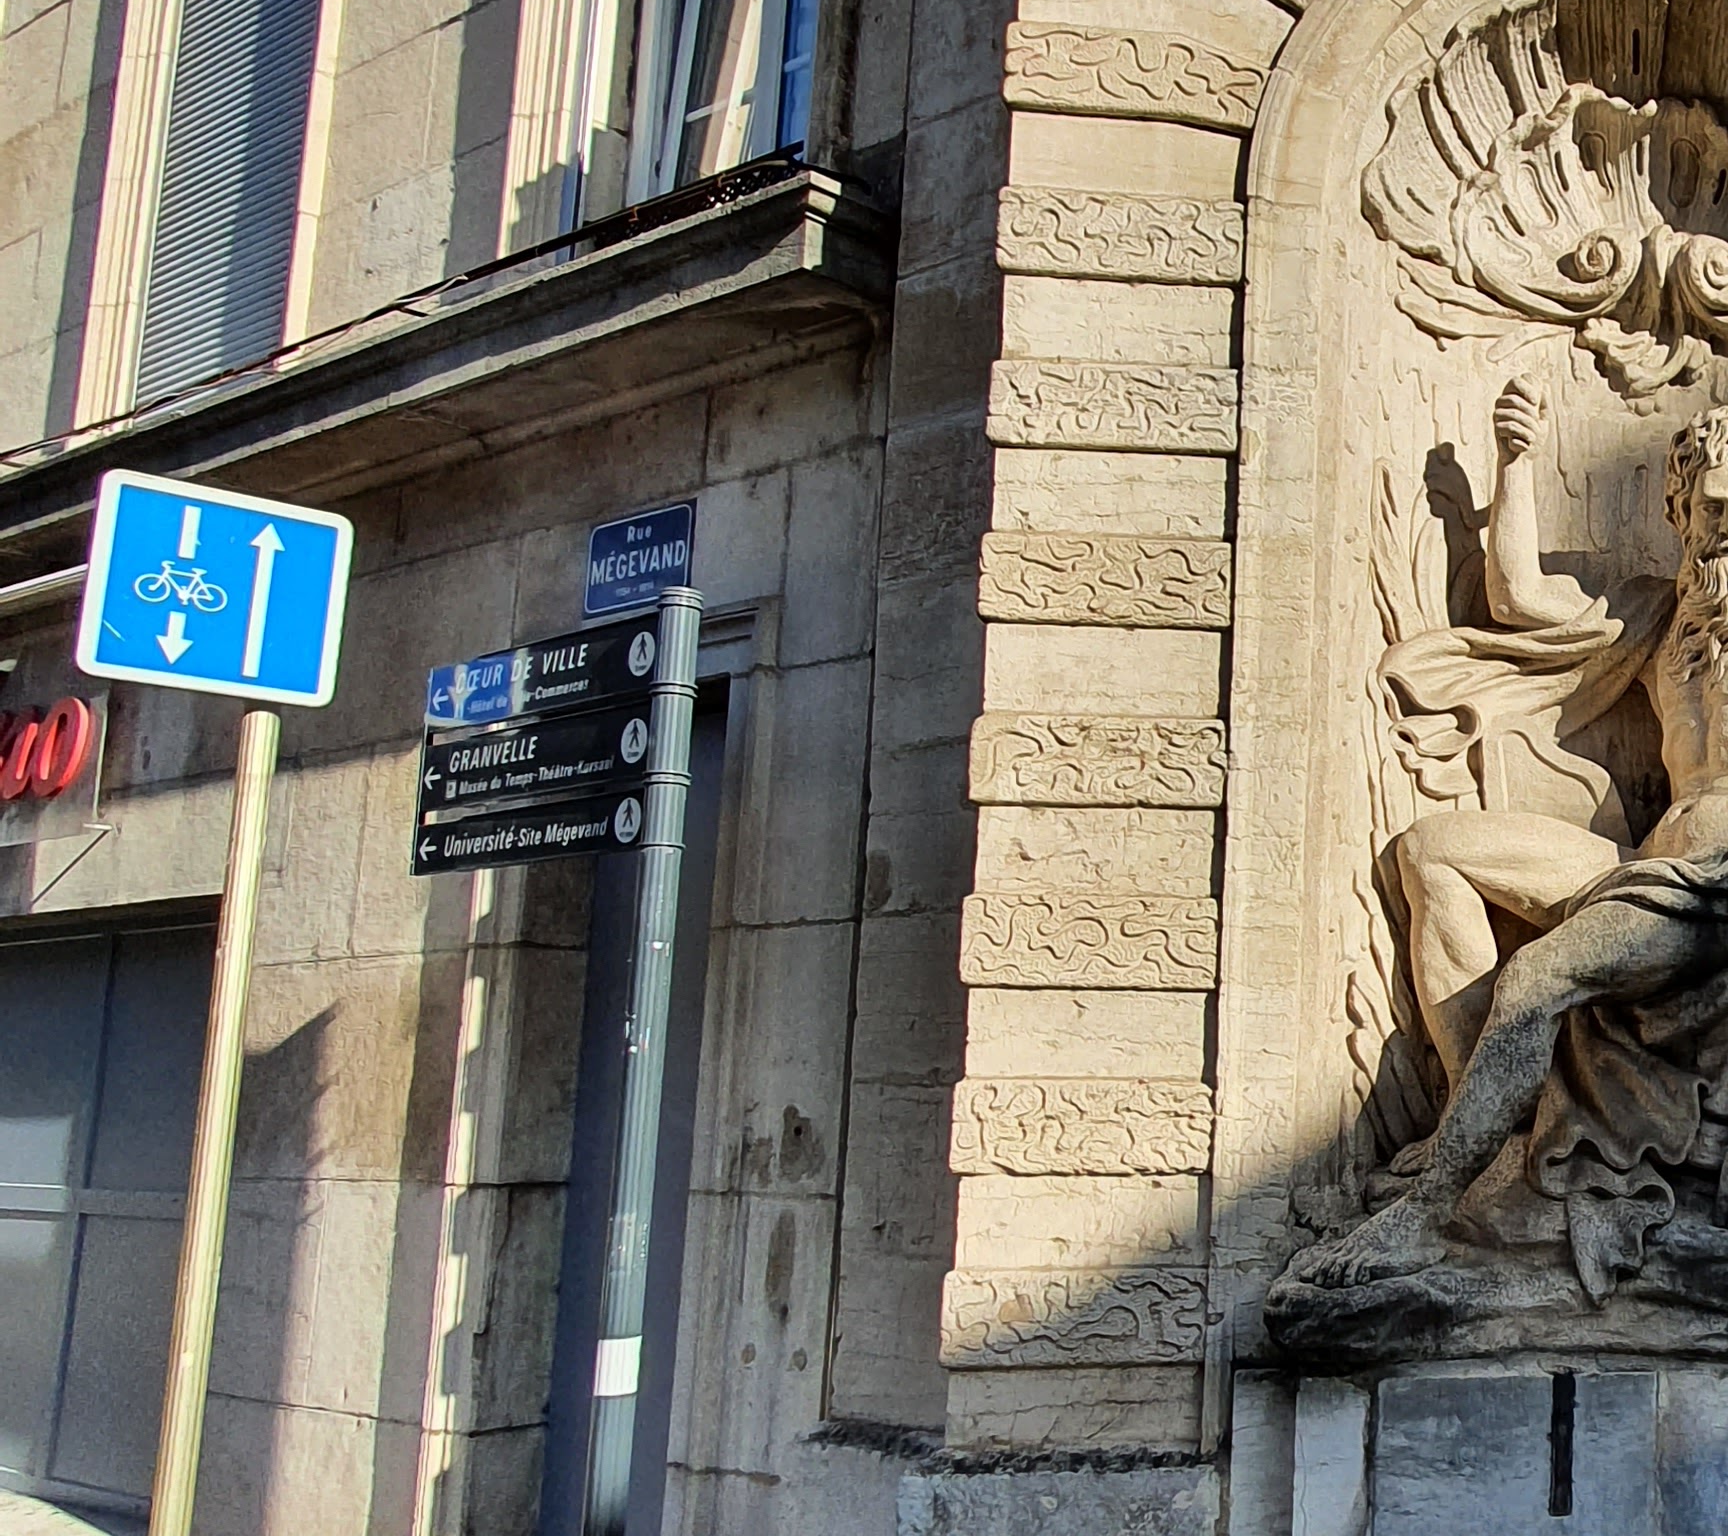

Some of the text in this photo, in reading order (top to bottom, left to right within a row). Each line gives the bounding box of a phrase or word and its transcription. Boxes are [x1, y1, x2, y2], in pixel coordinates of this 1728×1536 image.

[626, 525, 652, 543] Rue
[590, 539, 687, 586] MÉGEVAND
[454, 643, 590, 695] CŒUR DE VILLE
[449, 735, 539, 774] GRANVELLE
[458, 777, 488, 795] Musée
[490, 774, 501, 790] du
[443, 817, 609, 858] Université-Site Mégevand
